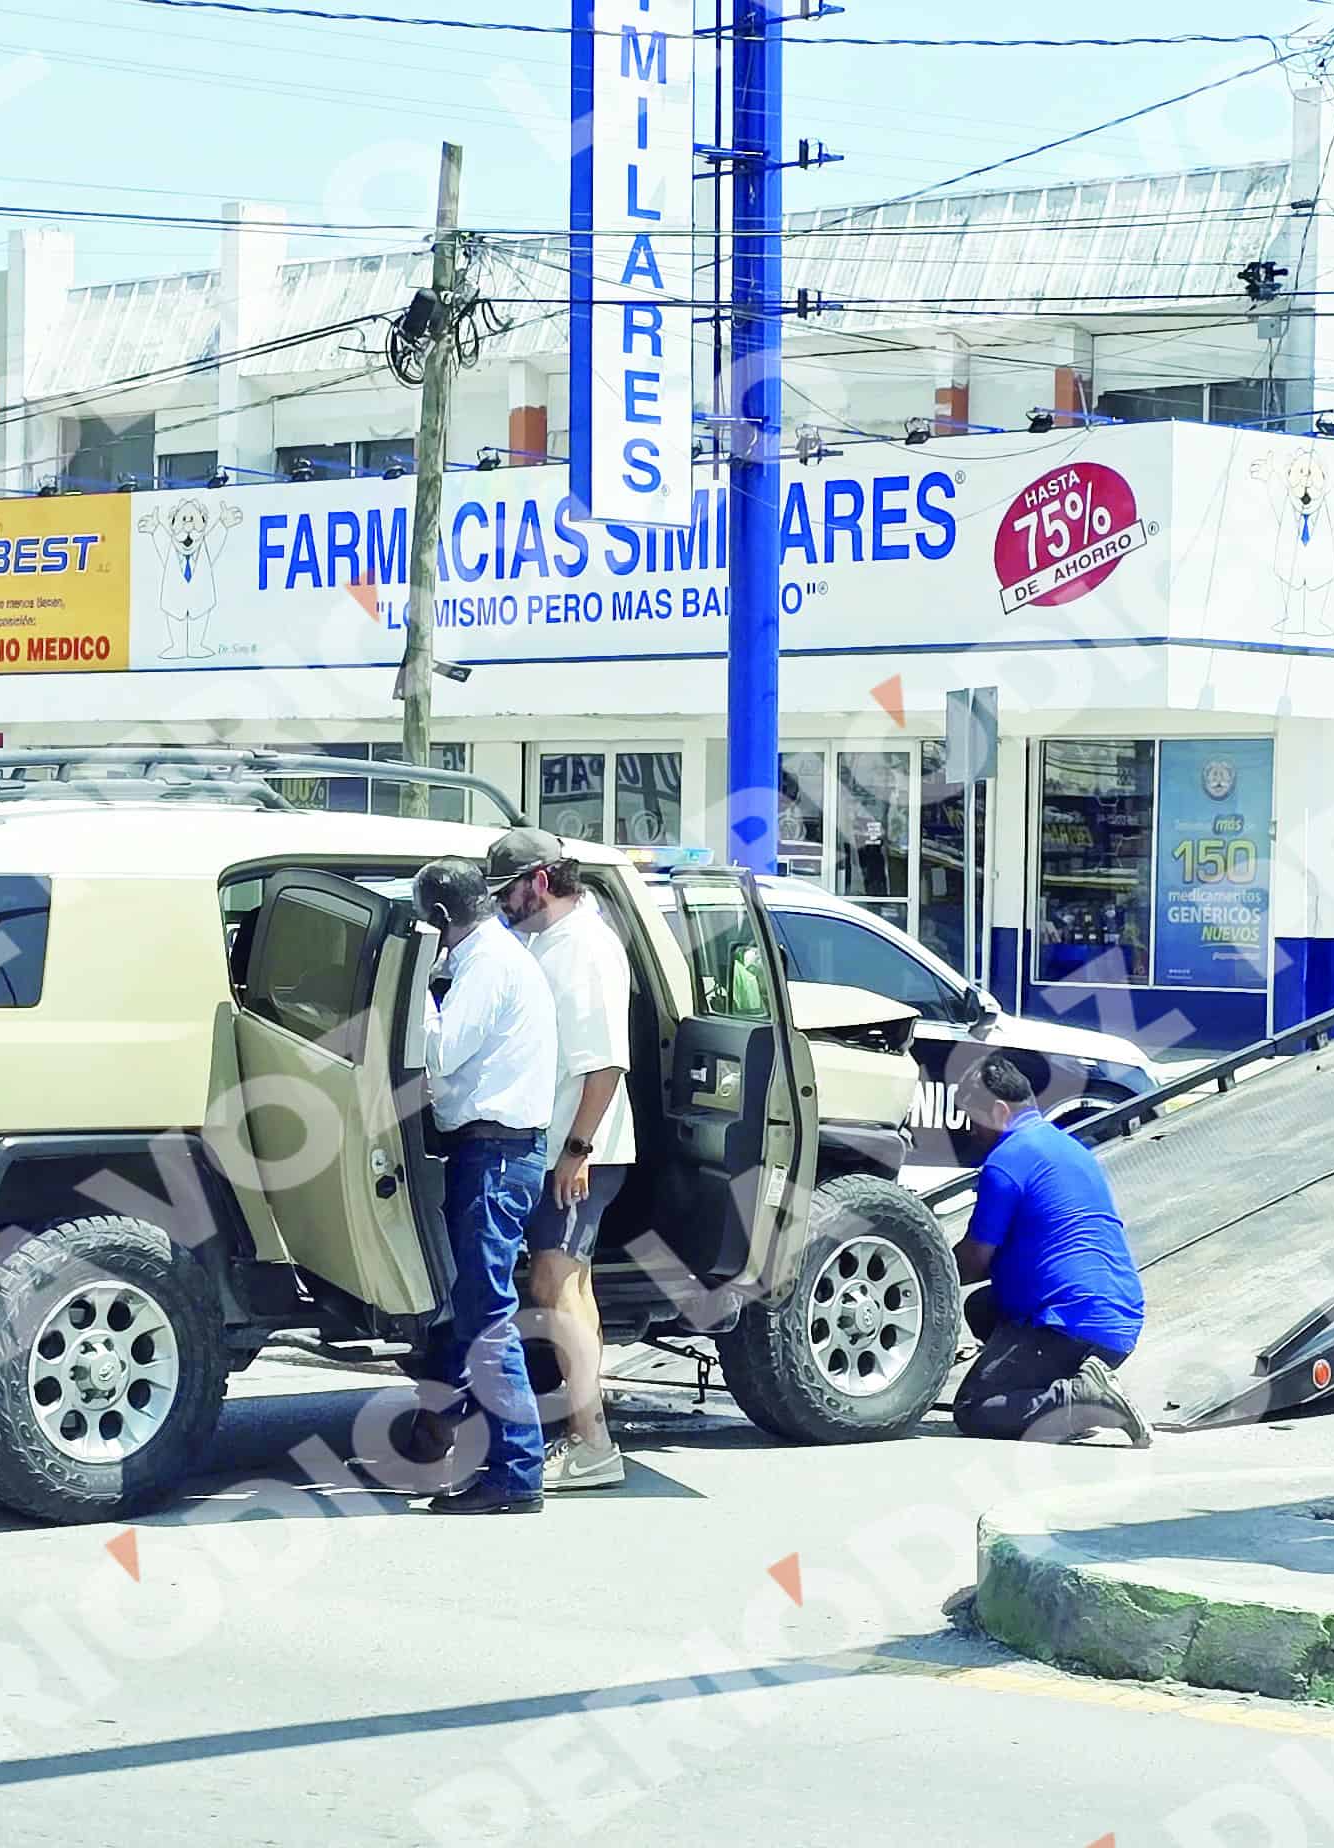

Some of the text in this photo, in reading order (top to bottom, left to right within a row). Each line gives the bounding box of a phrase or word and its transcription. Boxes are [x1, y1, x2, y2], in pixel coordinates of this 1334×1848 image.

[620, 0, 667, 494] MILARES
[1025, 470, 1080, 508] HASTA
[604, 472, 957, 577] SIMIARES
[1013, 481, 1111, 571] 75%
[1014, 533, 1132, 603] DE AHORRO
[5, 599, 35, 609] menos
[376, 601, 410, 630] "L
[434, 595, 518, 628] MISMO
[528, 589, 603, 625] PERO
[612, 588, 673, 622] MAS
[26, 635, 112, 662] MEDICO
[1215, 818, 1244, 834] más
[1172, 839, 1258, 885] 150
[1168, 902, 1261, 925] GENÉRICOS
[1169, 888, 1262, 905] medicamentos
[1201, 926, 1260, 942] NUEVOS
